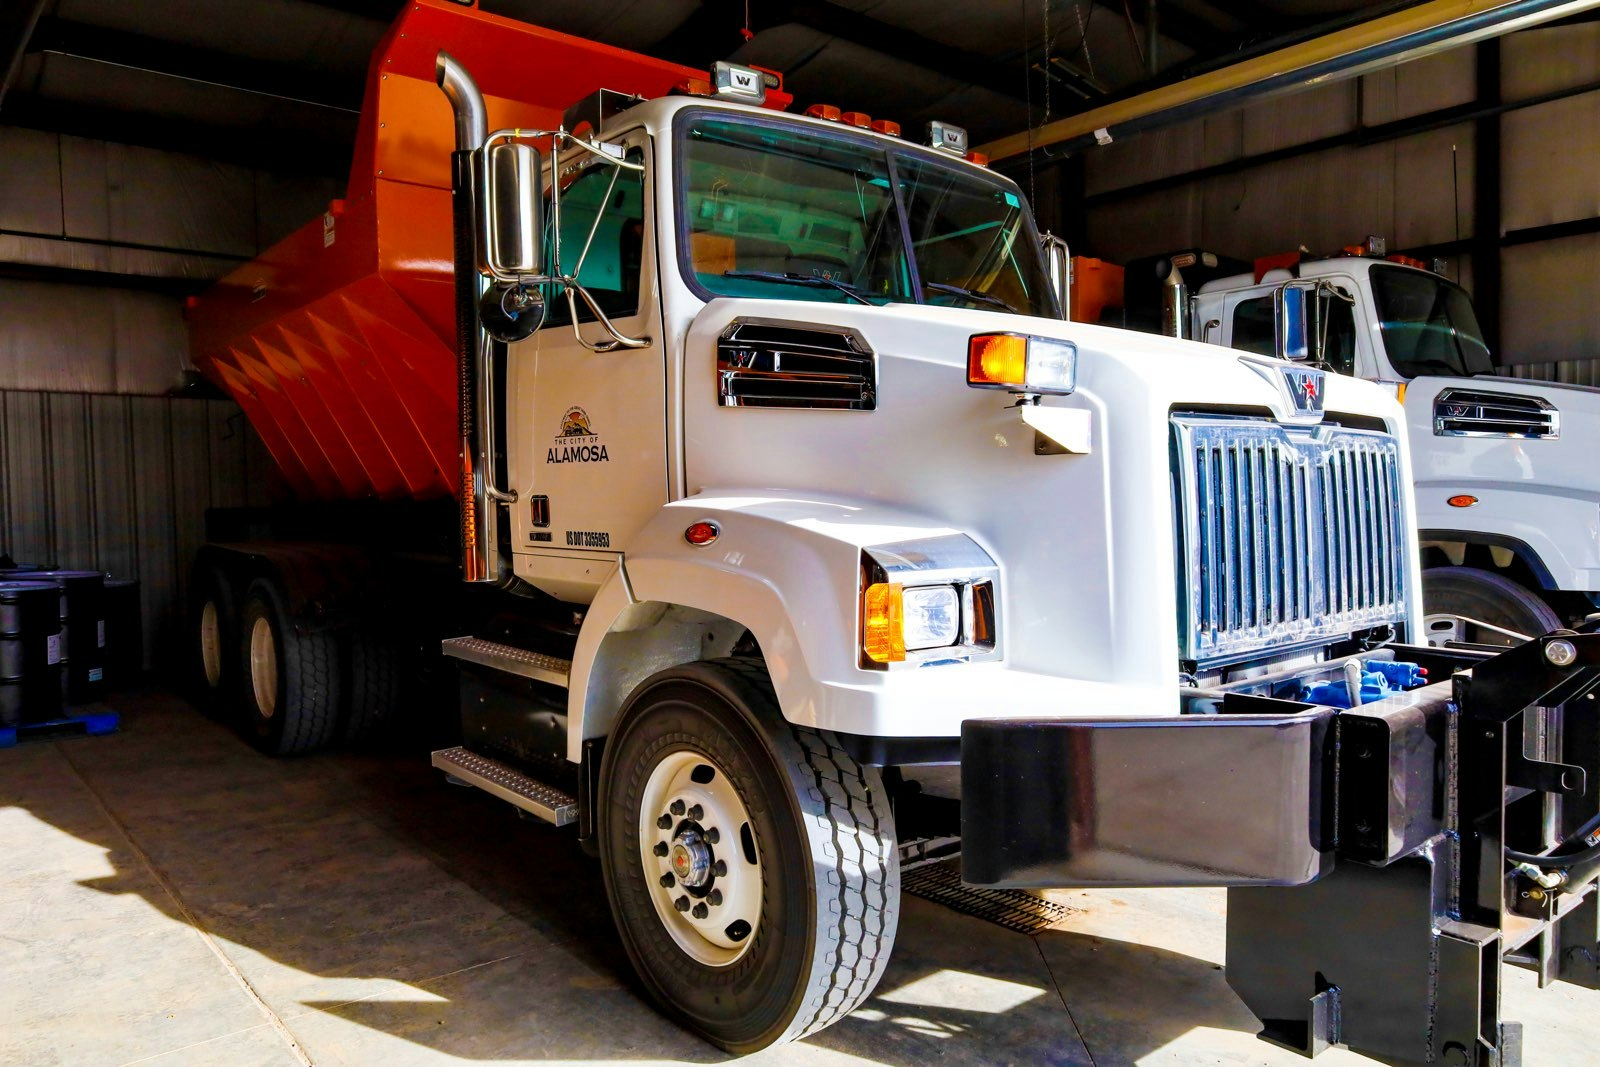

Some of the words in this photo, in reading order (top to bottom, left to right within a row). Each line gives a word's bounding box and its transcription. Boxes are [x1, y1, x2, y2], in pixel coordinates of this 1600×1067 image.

[570, 437, 586, 445] CITY
[546, 445, 609, 464] ALAMOSA
[566, 531, 574, 545] US
[574, 531, 584, 546] DOT
